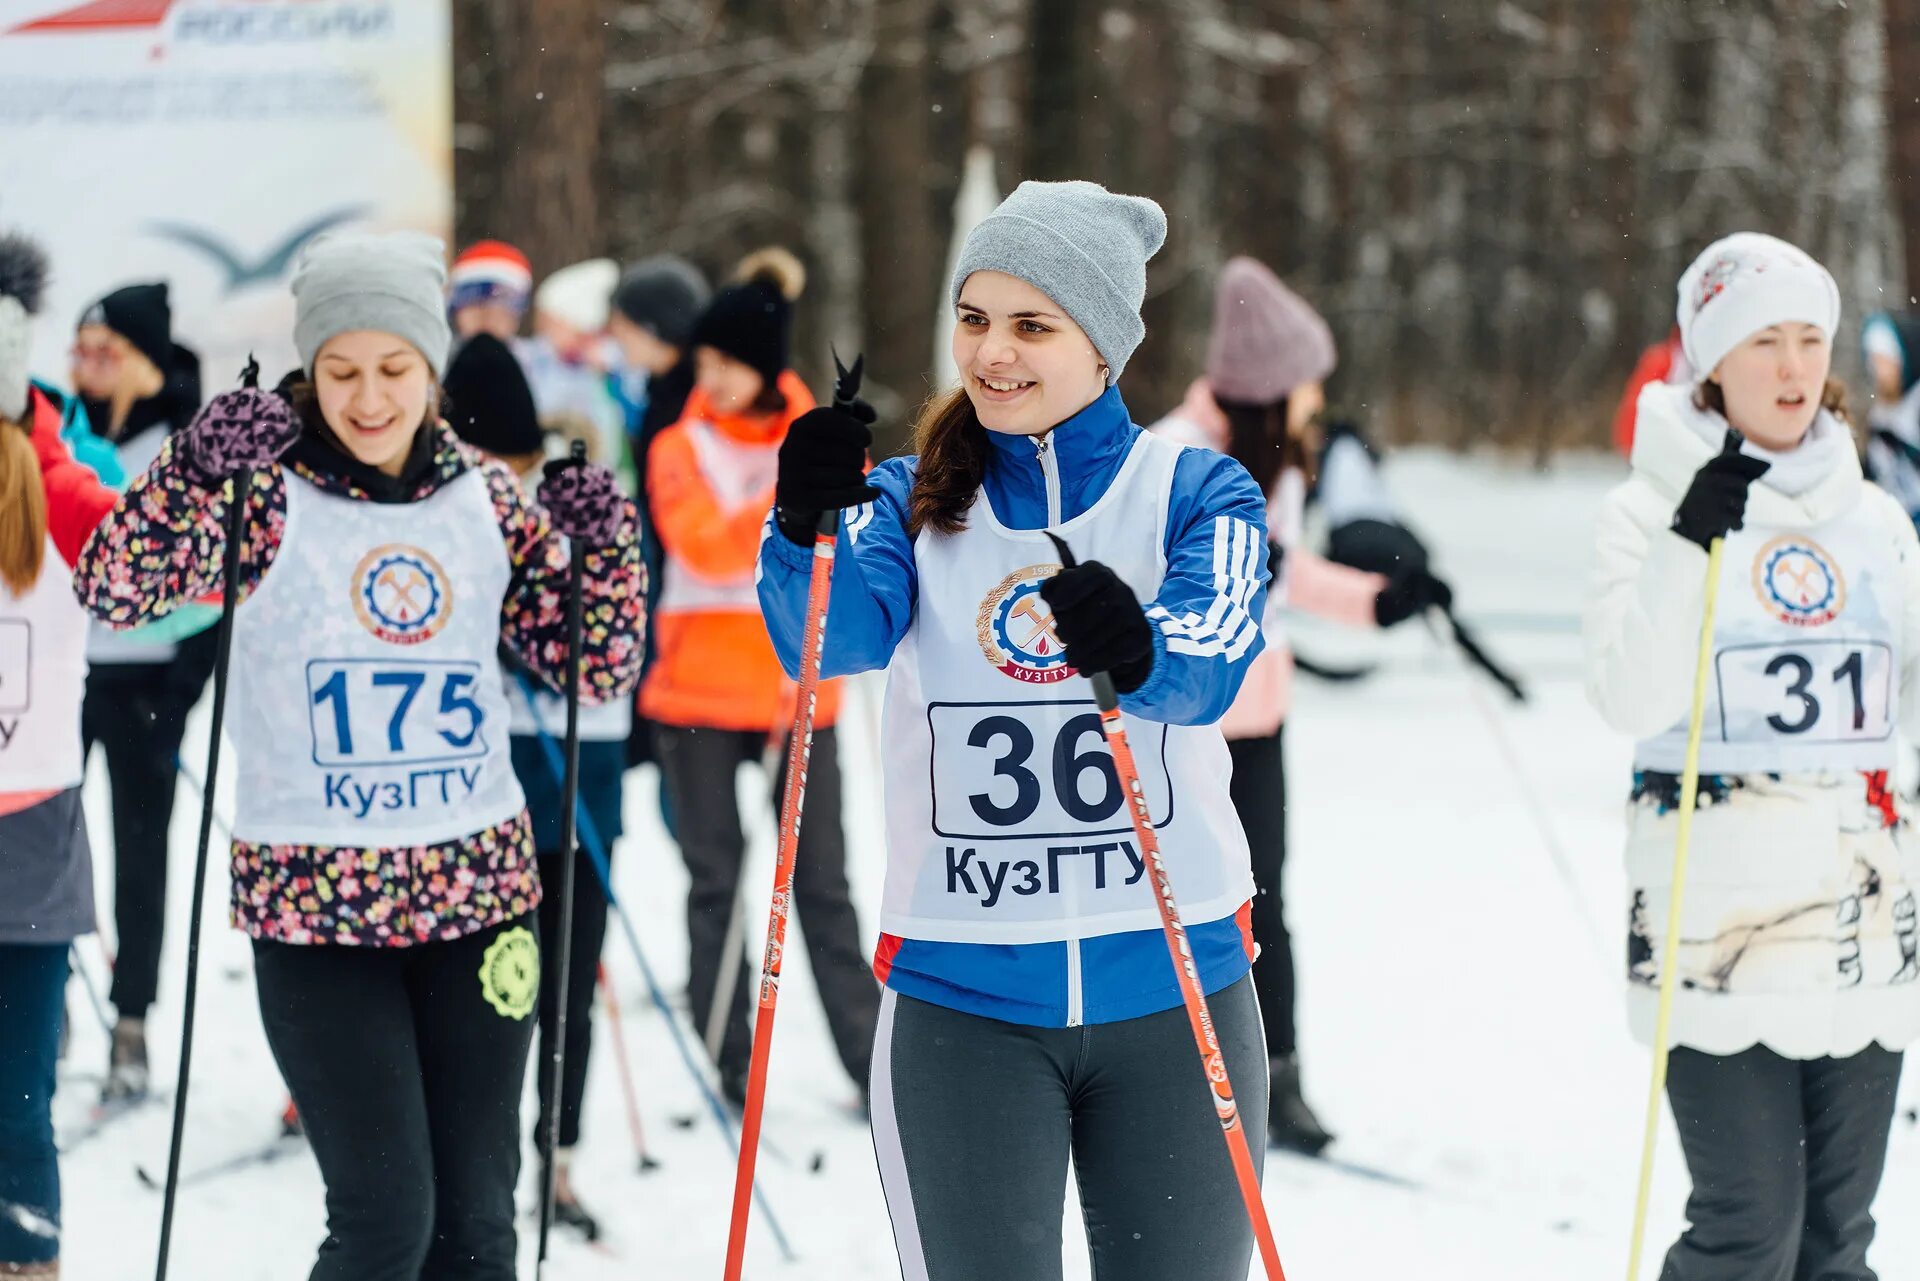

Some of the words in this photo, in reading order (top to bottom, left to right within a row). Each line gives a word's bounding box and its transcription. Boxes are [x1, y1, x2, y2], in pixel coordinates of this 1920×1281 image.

[1031, 566, 1056, 576] 1950
[1013, 666, 1069, 682] КУЗГТУ
[1763, 651, 1866, 735] 31
[314, 670, 485, 754] 175
[325, 763, 482, 818] КузГТУ
[966, 713, 1127, 827] 36
[945, 840, 1147, 908] КузГТУ
